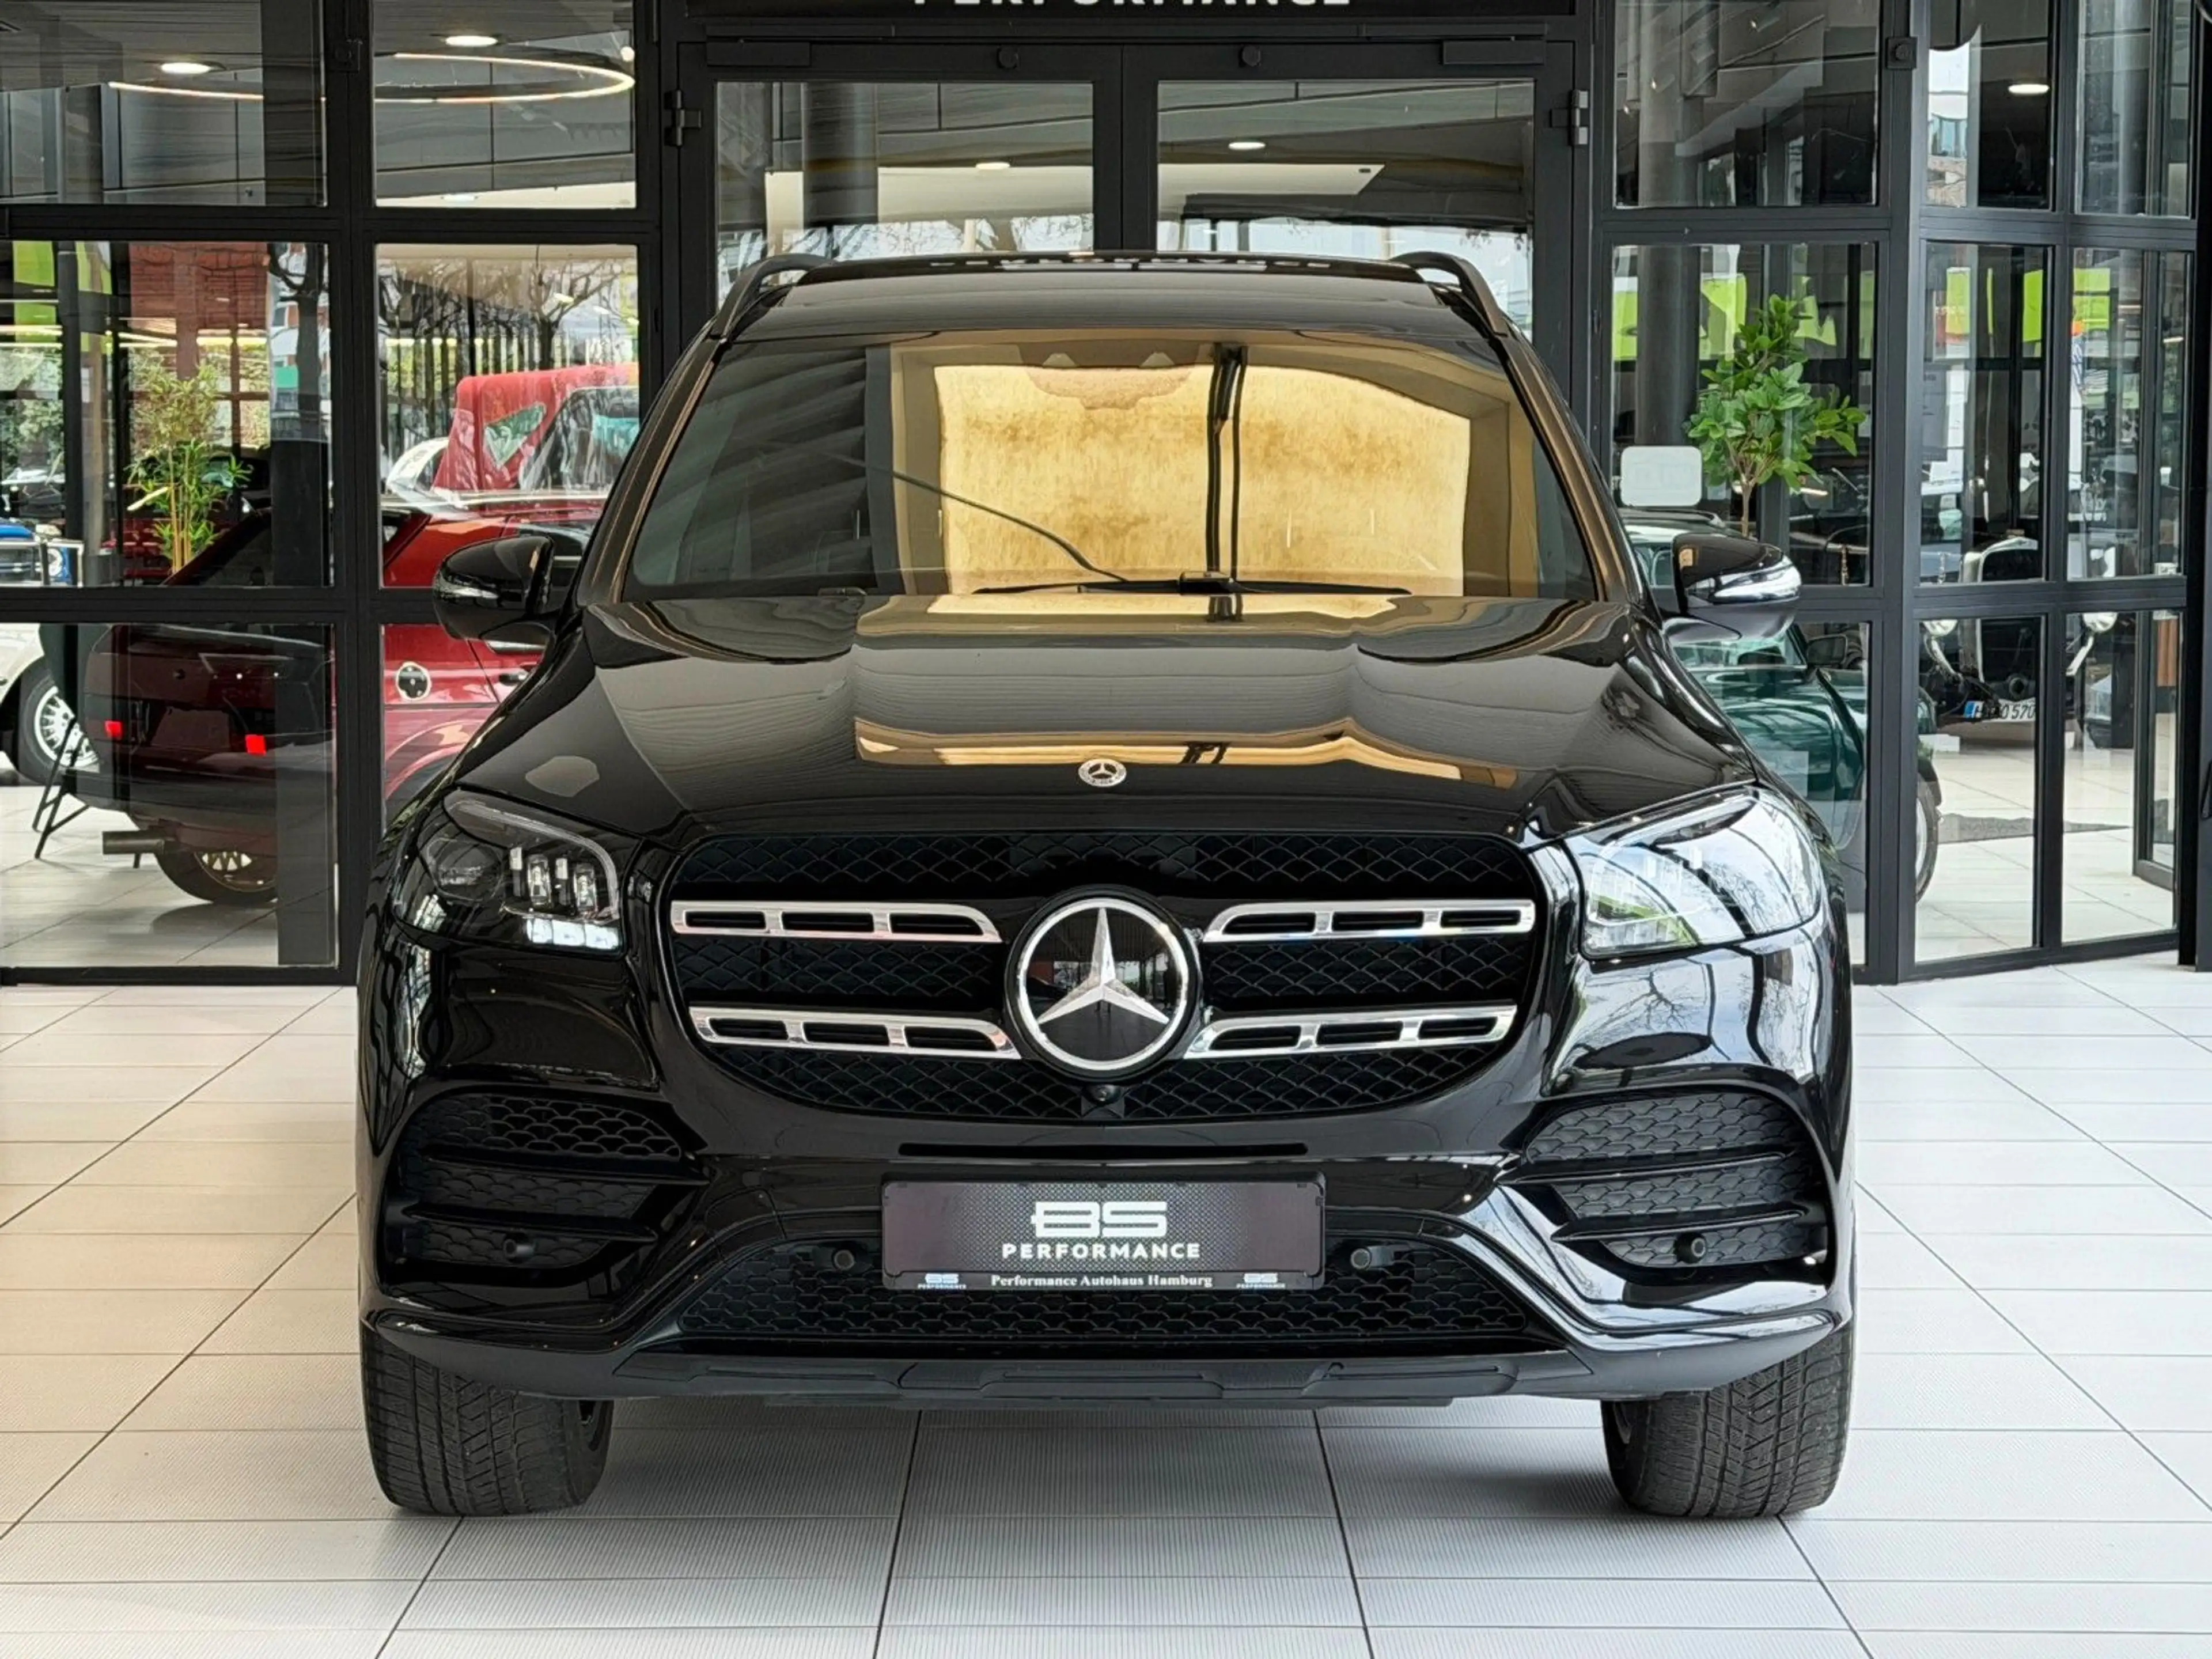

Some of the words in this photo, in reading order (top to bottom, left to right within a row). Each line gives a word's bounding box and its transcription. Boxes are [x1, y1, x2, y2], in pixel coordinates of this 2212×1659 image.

[1002, 1243, 1200, 1259] PERFORMANCE
[991, 1274, 1078, 1286] Performance
[1080, 1274, 1144, 1286] Autohaus
[1147, 1274, 1213, 1288] Hamburg
